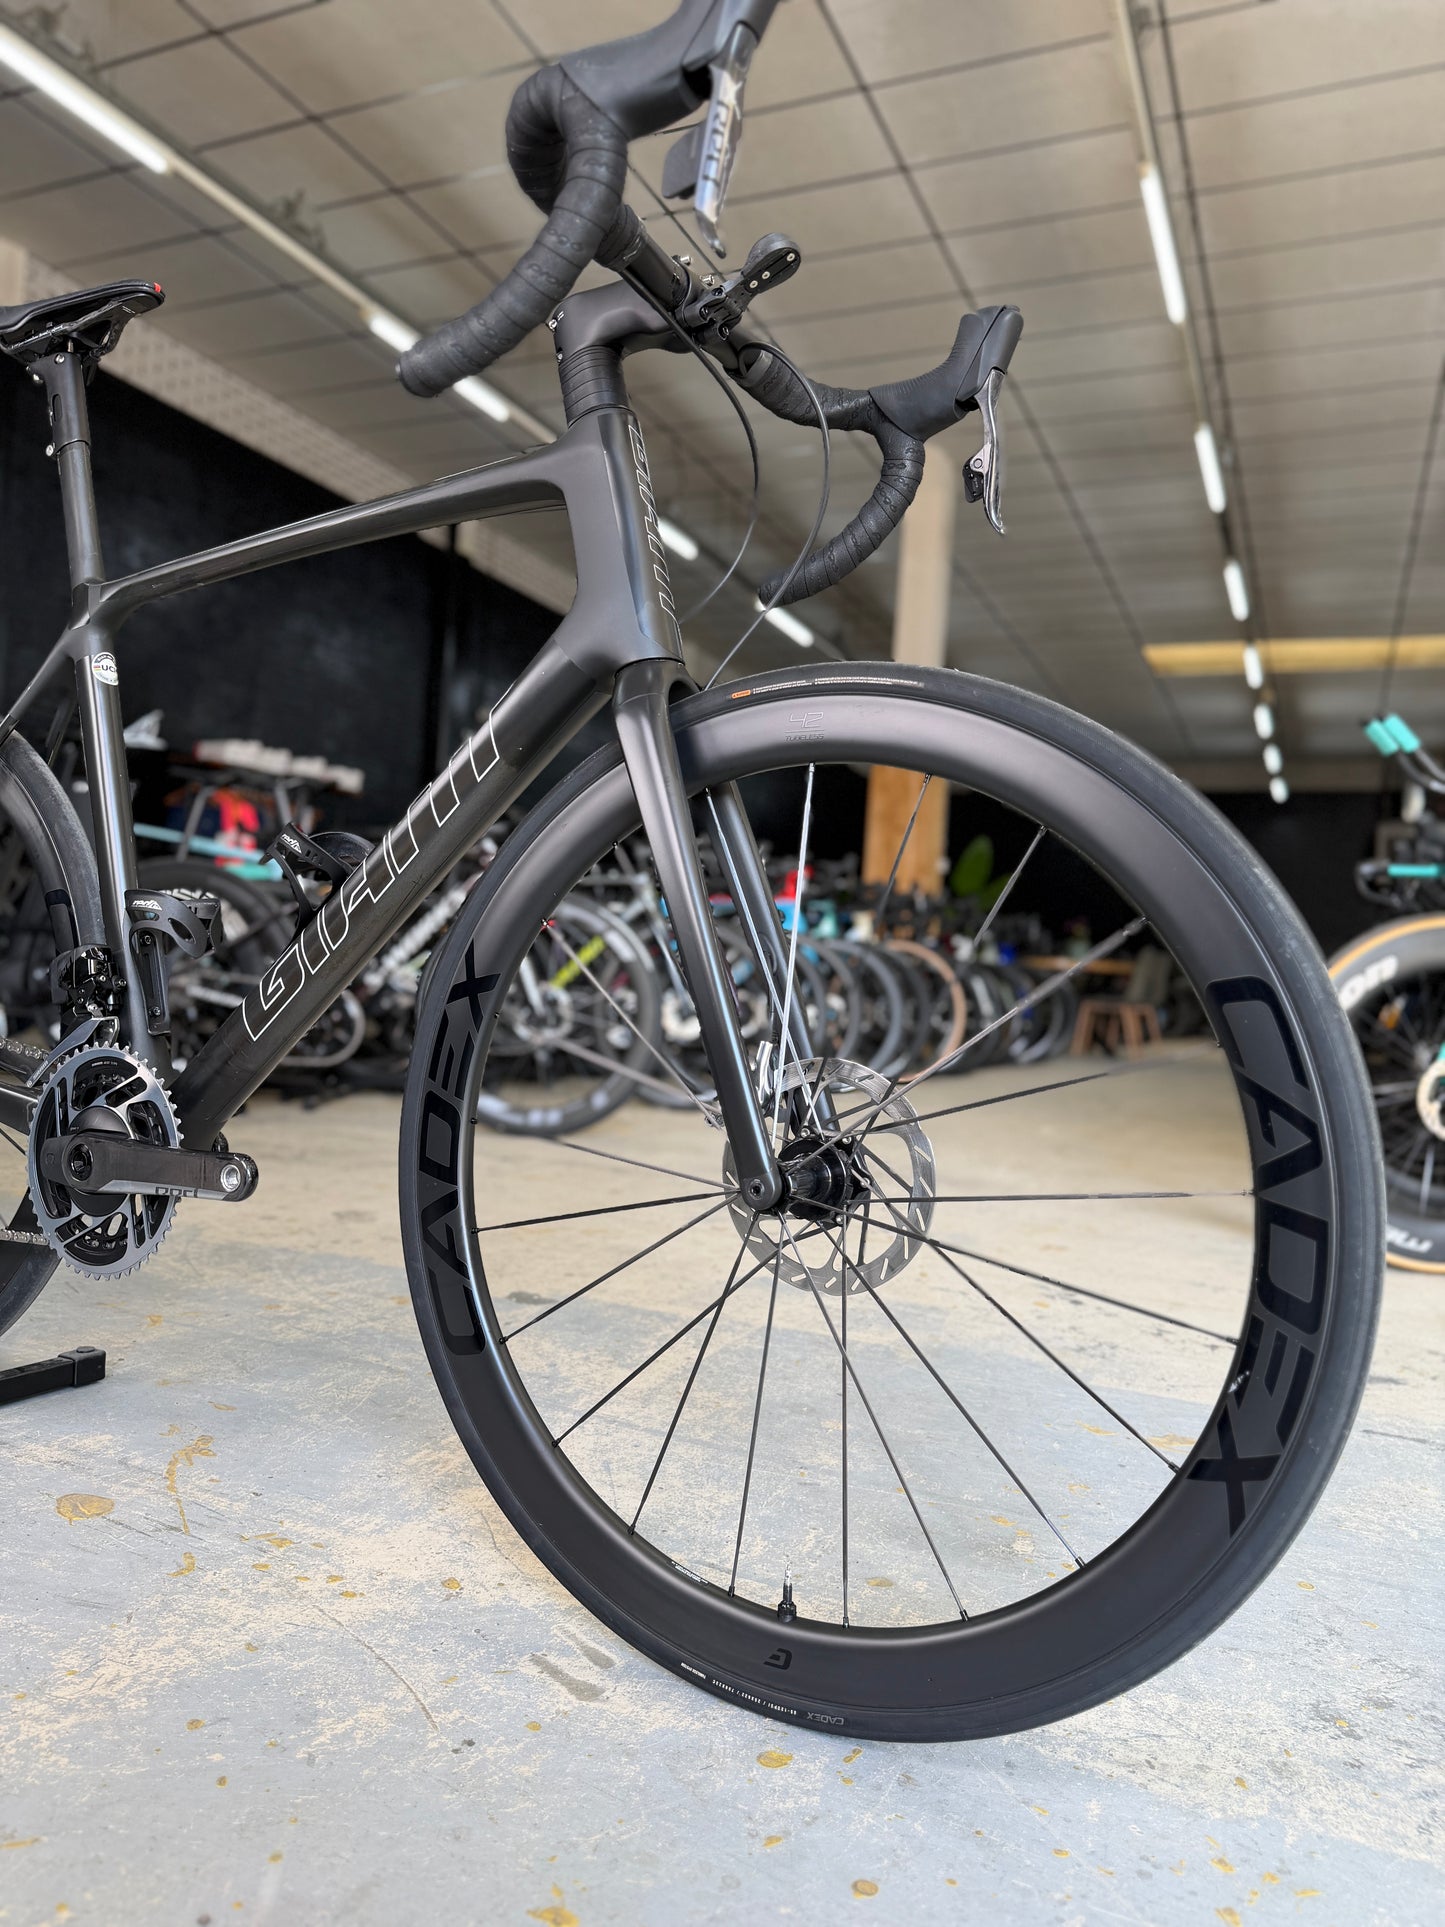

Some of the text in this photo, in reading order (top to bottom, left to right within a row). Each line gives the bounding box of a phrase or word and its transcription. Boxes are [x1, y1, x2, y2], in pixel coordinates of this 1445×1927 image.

[243, 682, 516, 1041] GIANT
[789, 711, 824, 728] 42
[418, 938, 500, 1356] CADEX
[1186, 975, 1329, 1539] CADEX
[807, 1712, 845, 1726] CADEX
